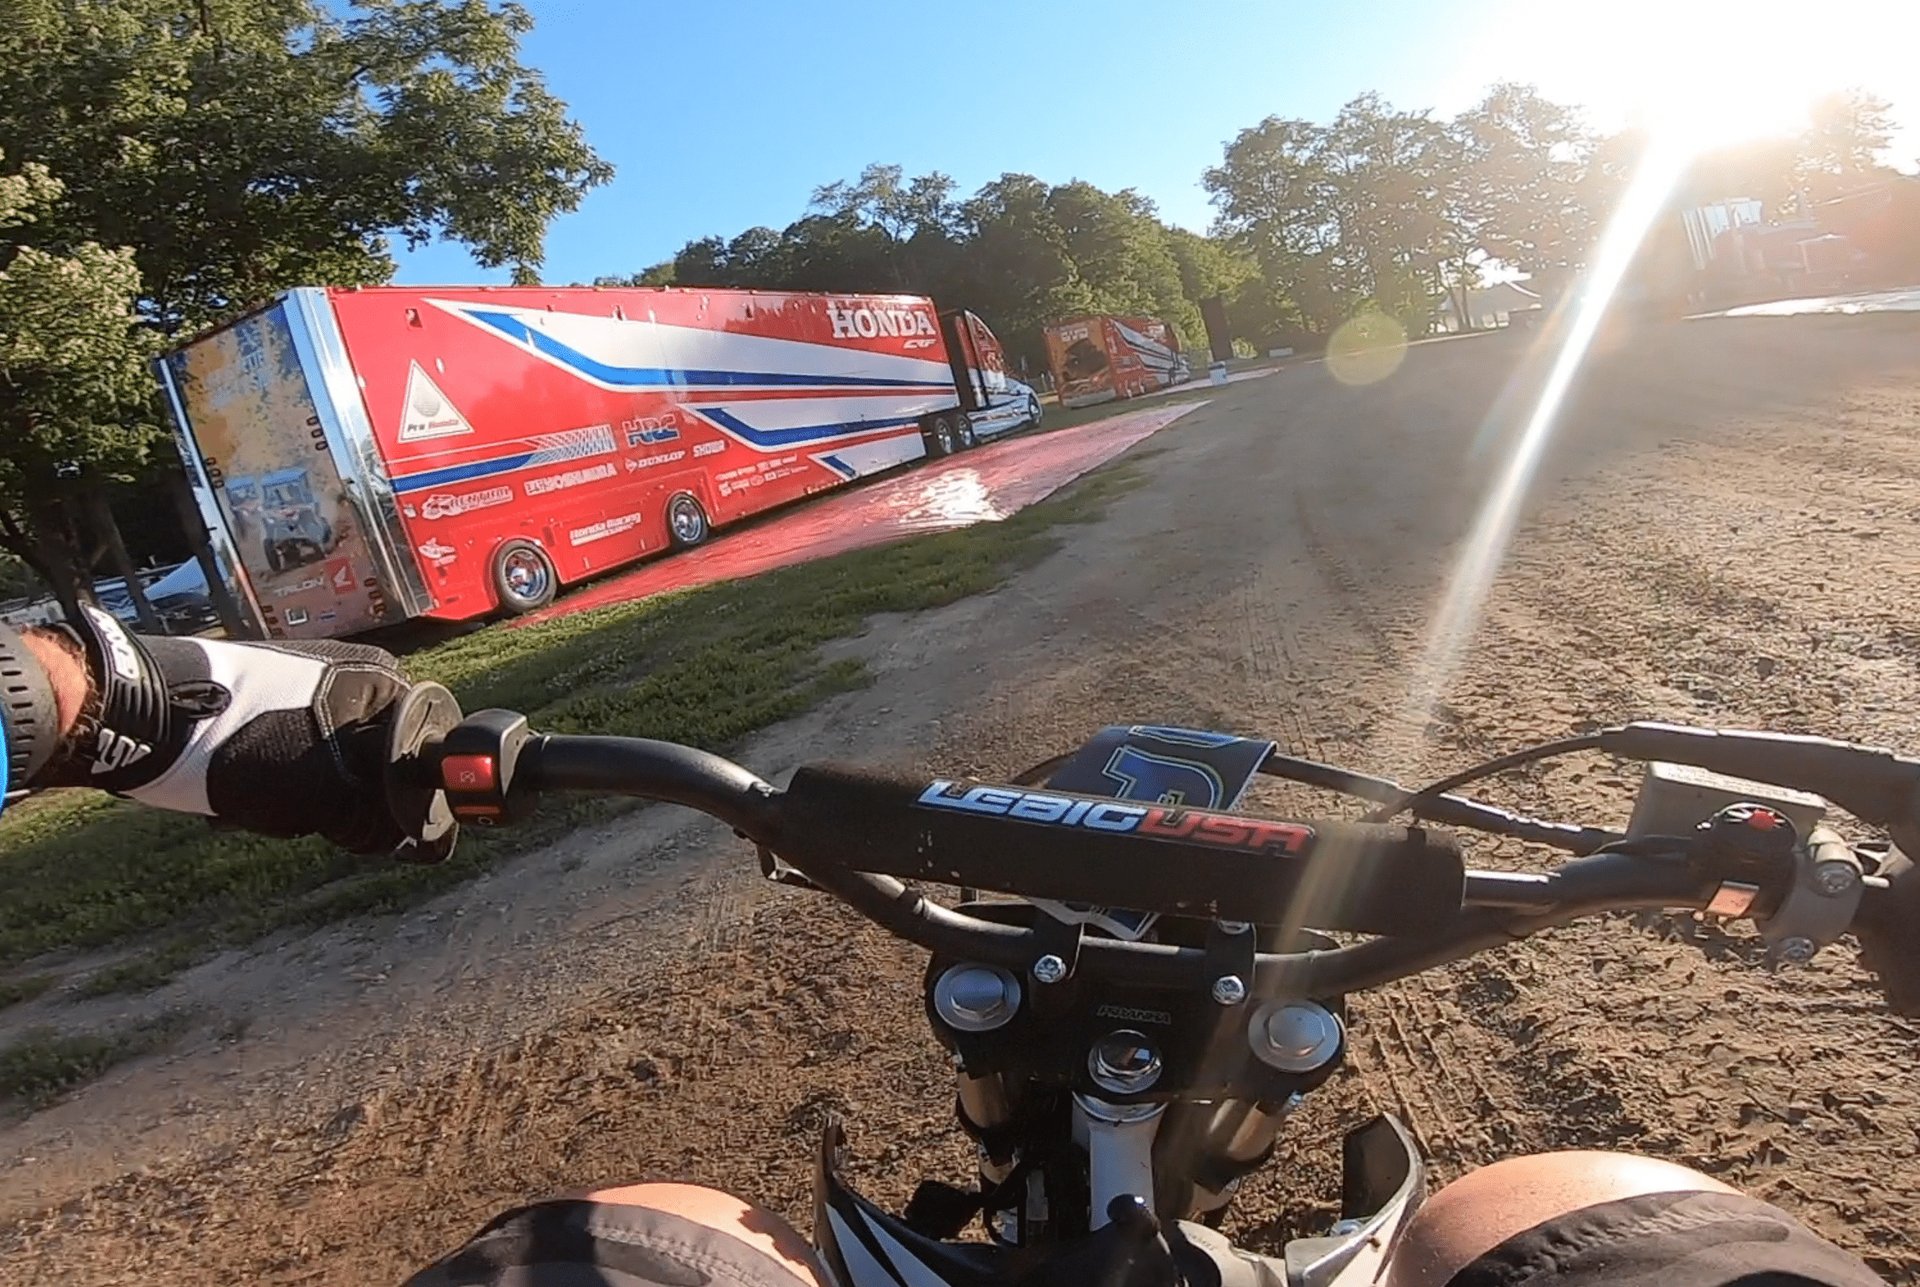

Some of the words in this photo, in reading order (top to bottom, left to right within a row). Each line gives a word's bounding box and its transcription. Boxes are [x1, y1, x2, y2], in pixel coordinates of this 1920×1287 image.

[826, 308, 937, 339] HONDA
[622, 414, 681, 448] HRC
[638, 450, 686, 469] DUNLOP
